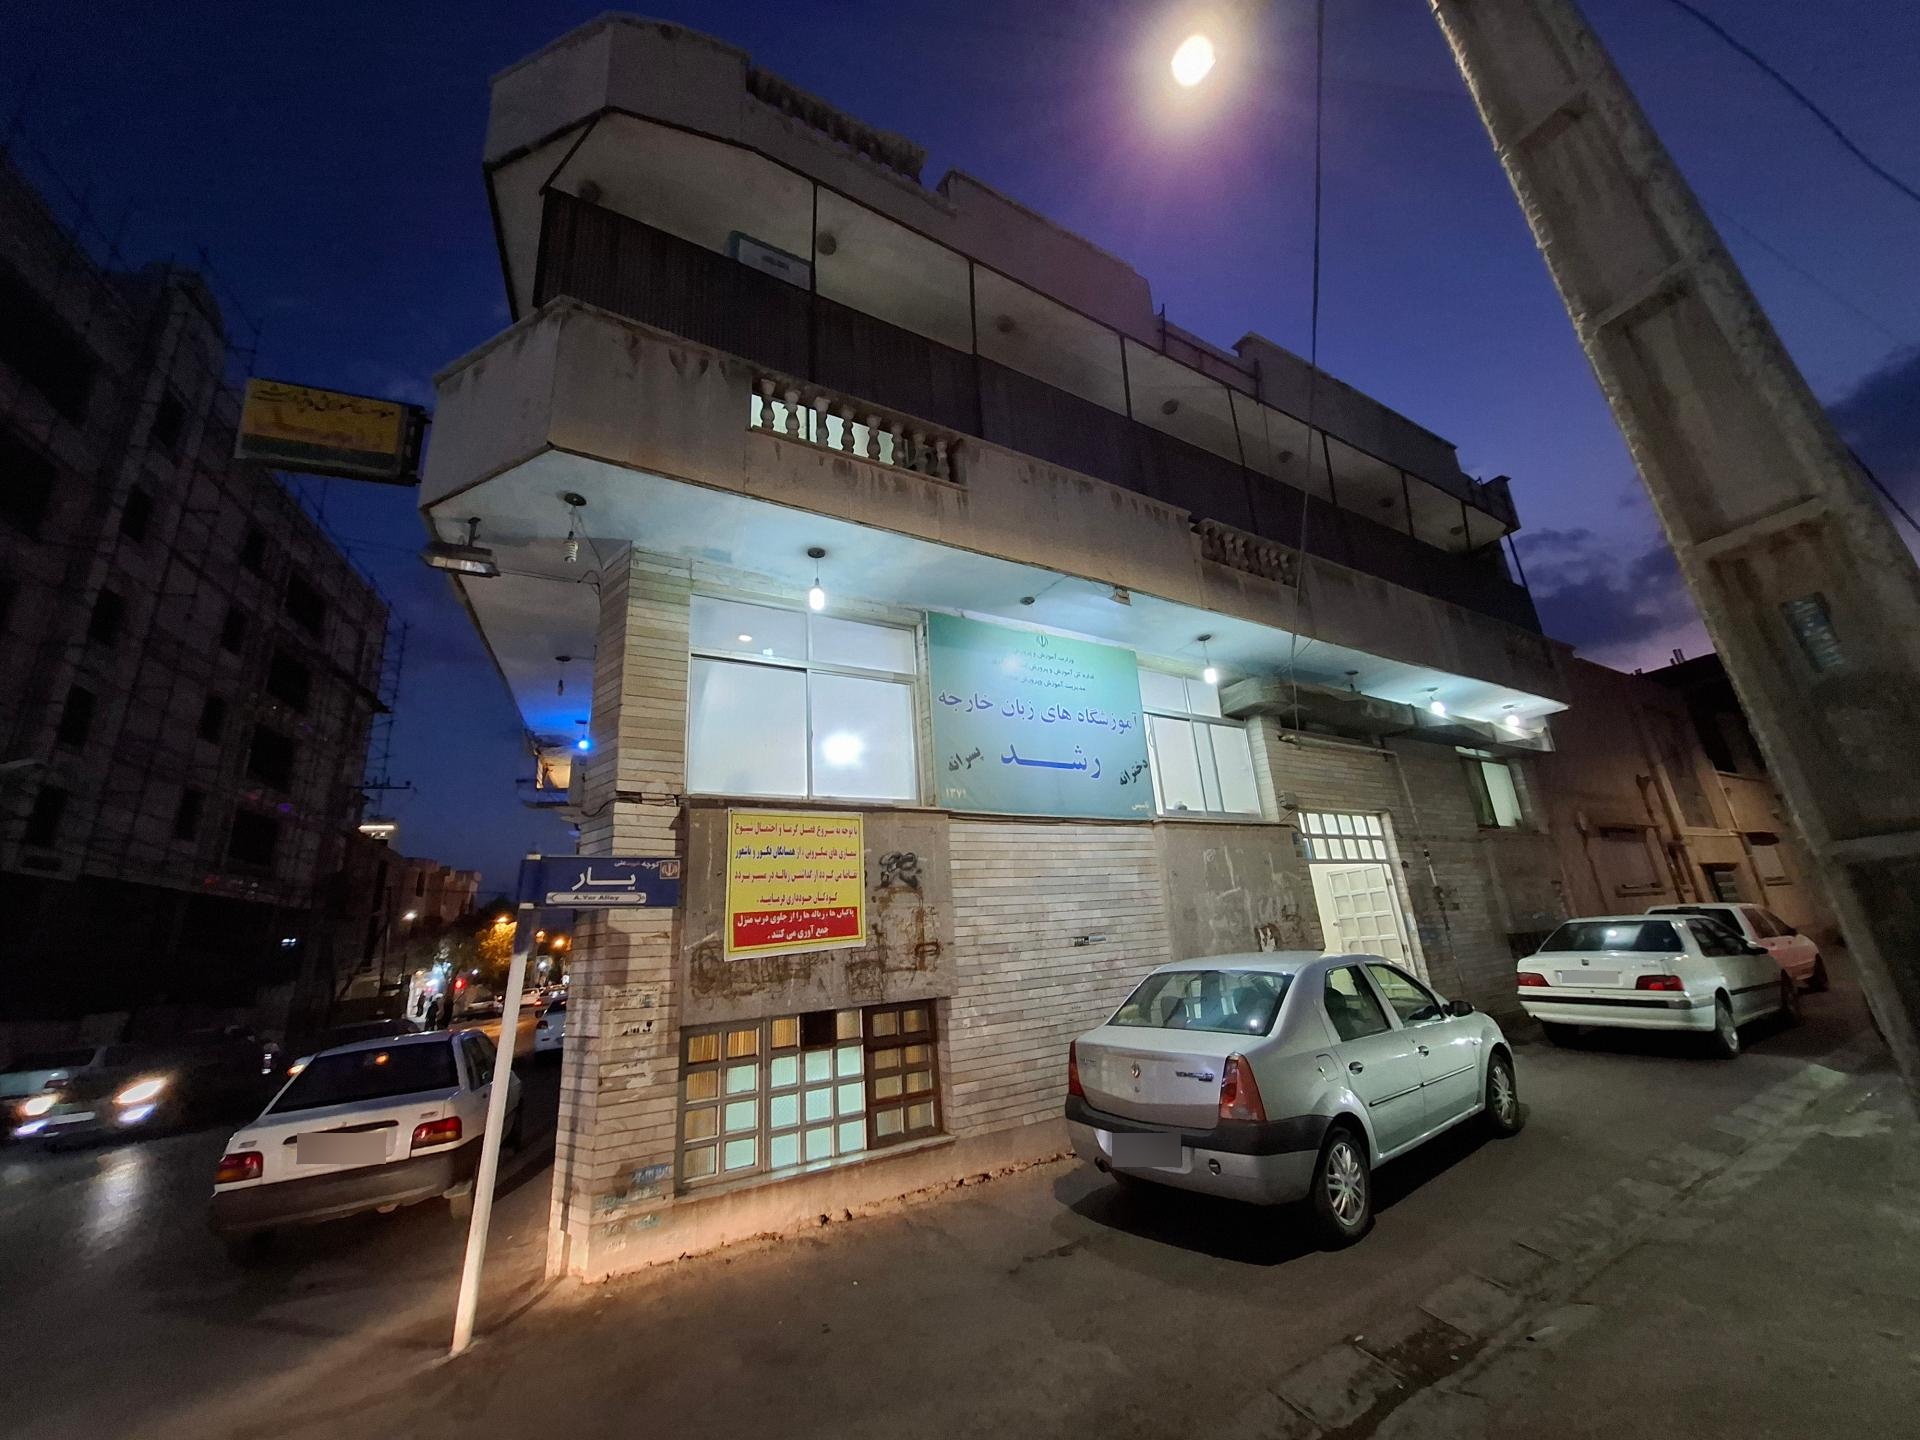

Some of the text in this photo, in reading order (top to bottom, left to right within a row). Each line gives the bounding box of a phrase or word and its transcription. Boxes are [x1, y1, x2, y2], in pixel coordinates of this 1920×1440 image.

[1053, 668, 1073, 678] آموزش
[1043, 679, 1064, 689] آموزش
[938, 691, 1137, 735] آموزشگاه های زبان خارجه
[947, 746, 985, 771] پسرانه
[1000, 744, 1101, 780] رشد
[1119, 758, 1149, 786] دخترانه
[734, 822, 753, 835] شیوع
[755, 822, 778, 835] احتمال
[783, 823, 799, 837] گرما
[800, 823, 815, 836] فصل
[816, 825, 834, 837] شروع
[841, 827, 852, 837] توجه
[828, 847, 837, 859] های
[641, 860, 660, 870] کوچه
[571, 866, 637, 891] یار
[775, 869, 790, 883] زباله
[598, 894, 620, 902] Alley
[786, 893, 812, 905] خودداری
[813, 891, 838, 905] کودکان
[770, 912, 788, 924] جلوی
[789, 911, 795, 923] از
[796, 911, 803, 922] را
[803, 910, 810, 918] ها
[811, 909, 825, 920] زباله
[828, 909, 836, 917] ها
[836, 908, 854, 918] پاکبان
[737, 914, 753, 927] منزل
[754, 914, 769, 926] درب
[771, 928, 785, 939] کنند
[786, 930, 796, 940] می
[797, 924, 815, 939] آوری
[815, 926, 829, 937] جمع
